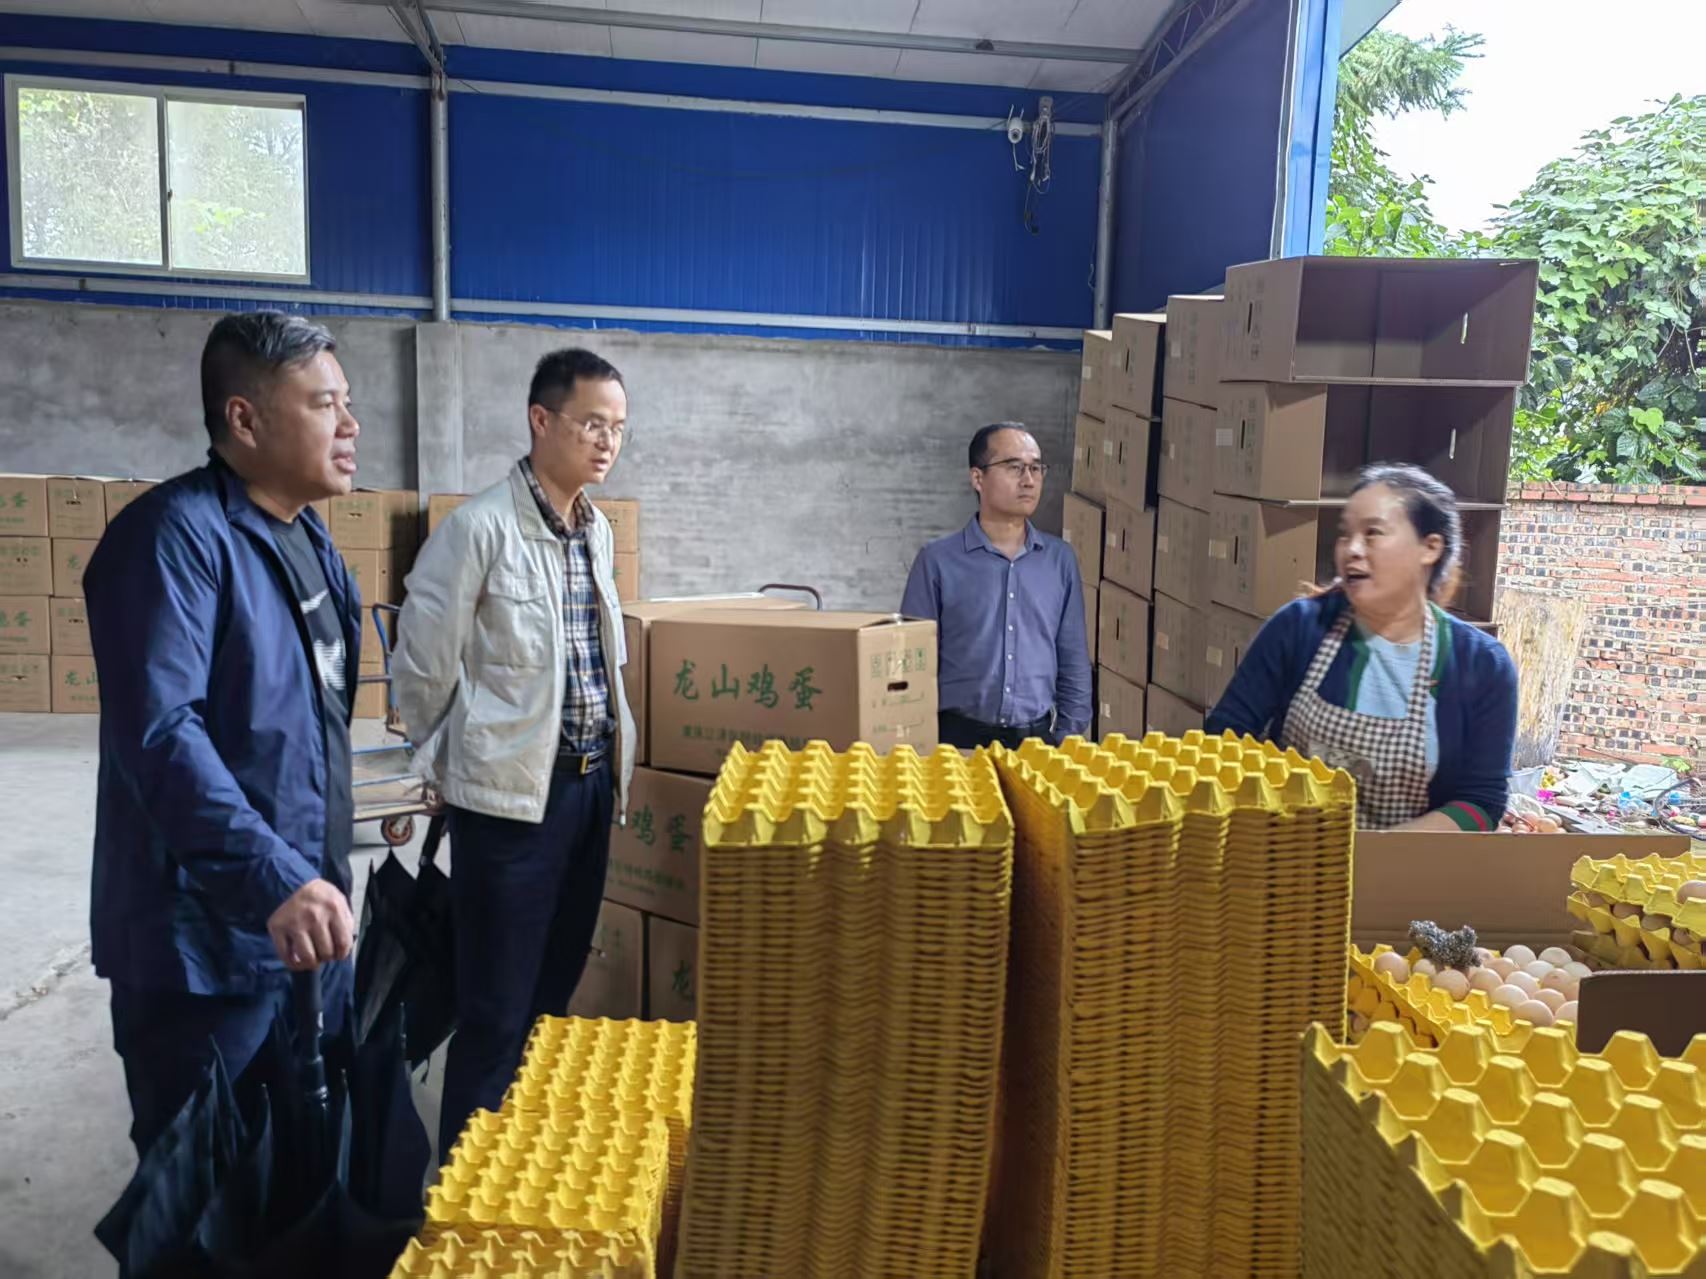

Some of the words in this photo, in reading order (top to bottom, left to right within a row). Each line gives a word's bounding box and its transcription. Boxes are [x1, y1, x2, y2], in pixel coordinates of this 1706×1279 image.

[673, 659, 824, 712] 龙山鸡蛋
[613, 803, 693, 853] 鸡蛋
